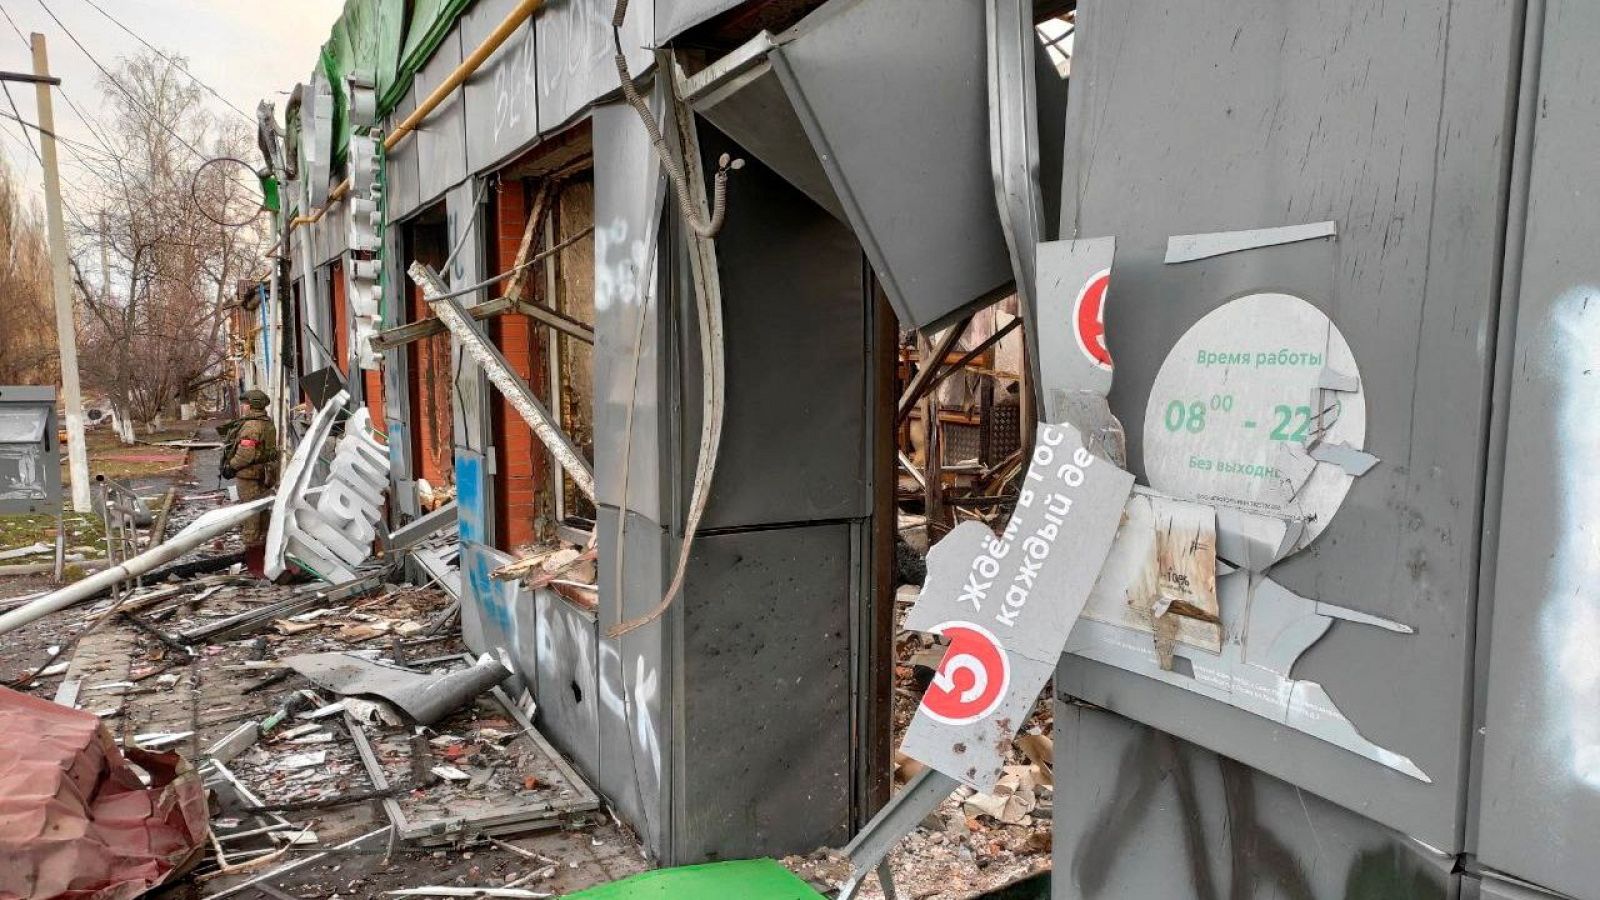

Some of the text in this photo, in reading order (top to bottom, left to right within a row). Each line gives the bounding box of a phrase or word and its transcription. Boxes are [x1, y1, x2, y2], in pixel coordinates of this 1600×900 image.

[1197, 348, 1323, 369] Время работы
[1164, 399, 1207, 434] 08
[1189, 455, 1212, 472] Без
[995, 493, 1073, 628] каждый
